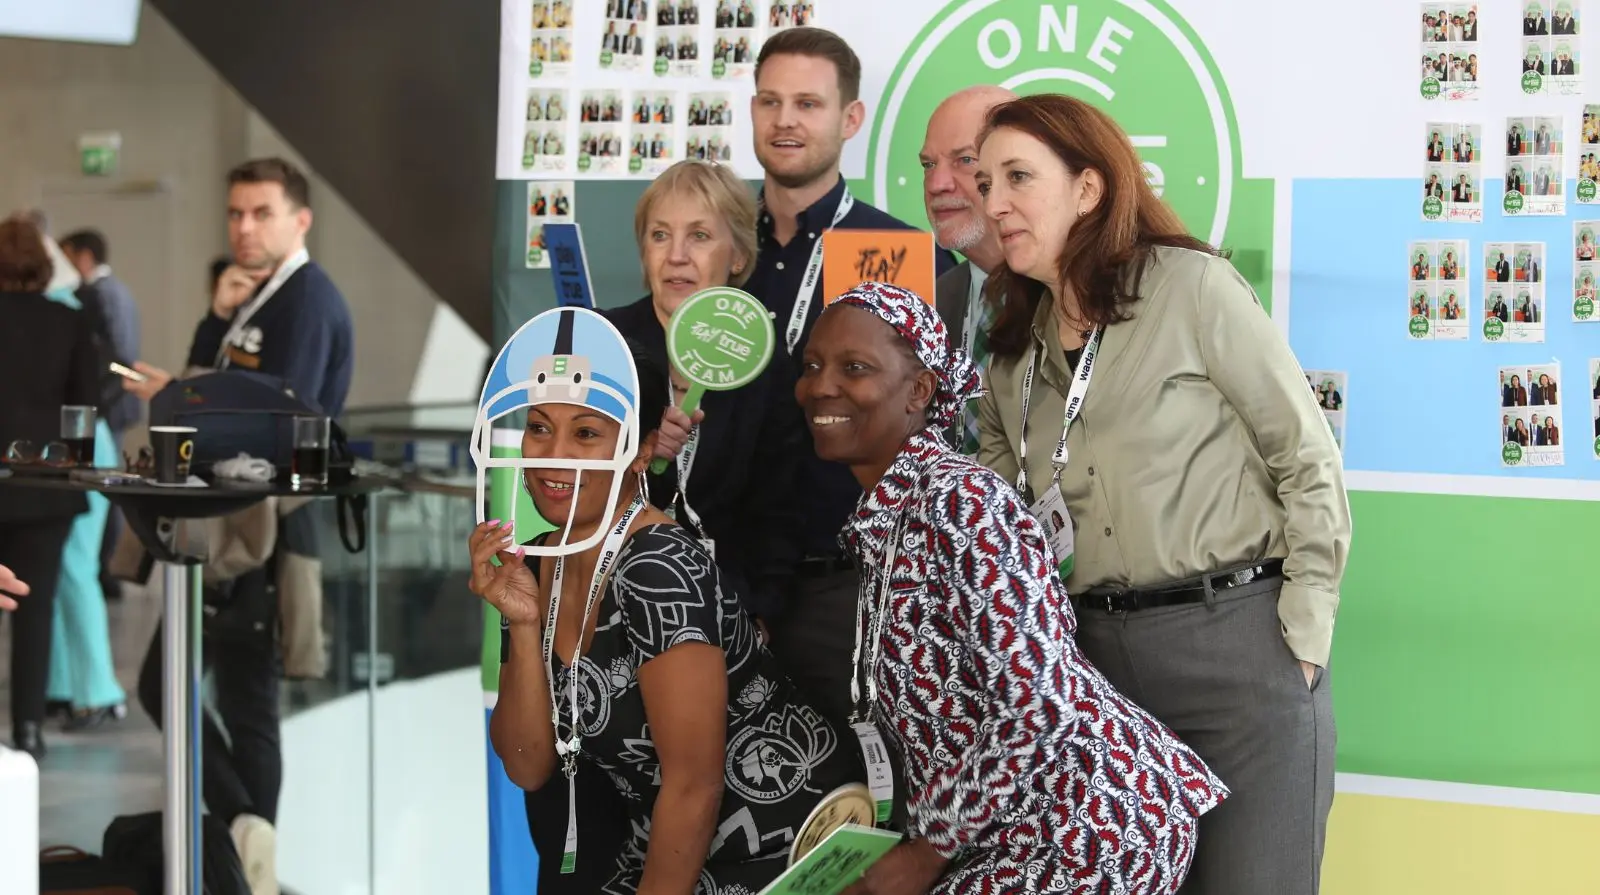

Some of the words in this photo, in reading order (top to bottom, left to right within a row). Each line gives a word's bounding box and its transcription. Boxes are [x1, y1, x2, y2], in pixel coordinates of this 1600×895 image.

[977, 5, 1134, 74] ONE
[805, 264, 817, 287] wada
[715, 298, 758, 324] ONE
[796, 300, 806, 320] ama
[719, 334, 751, 356] true
[680, 350, 735, 383] TEAM
[1080, 352, 1094, 381] wada
[1066, 396, 1080, 419] ama
[614, 510, 633, 535] wada
[599, 550, 614, 574] ama
